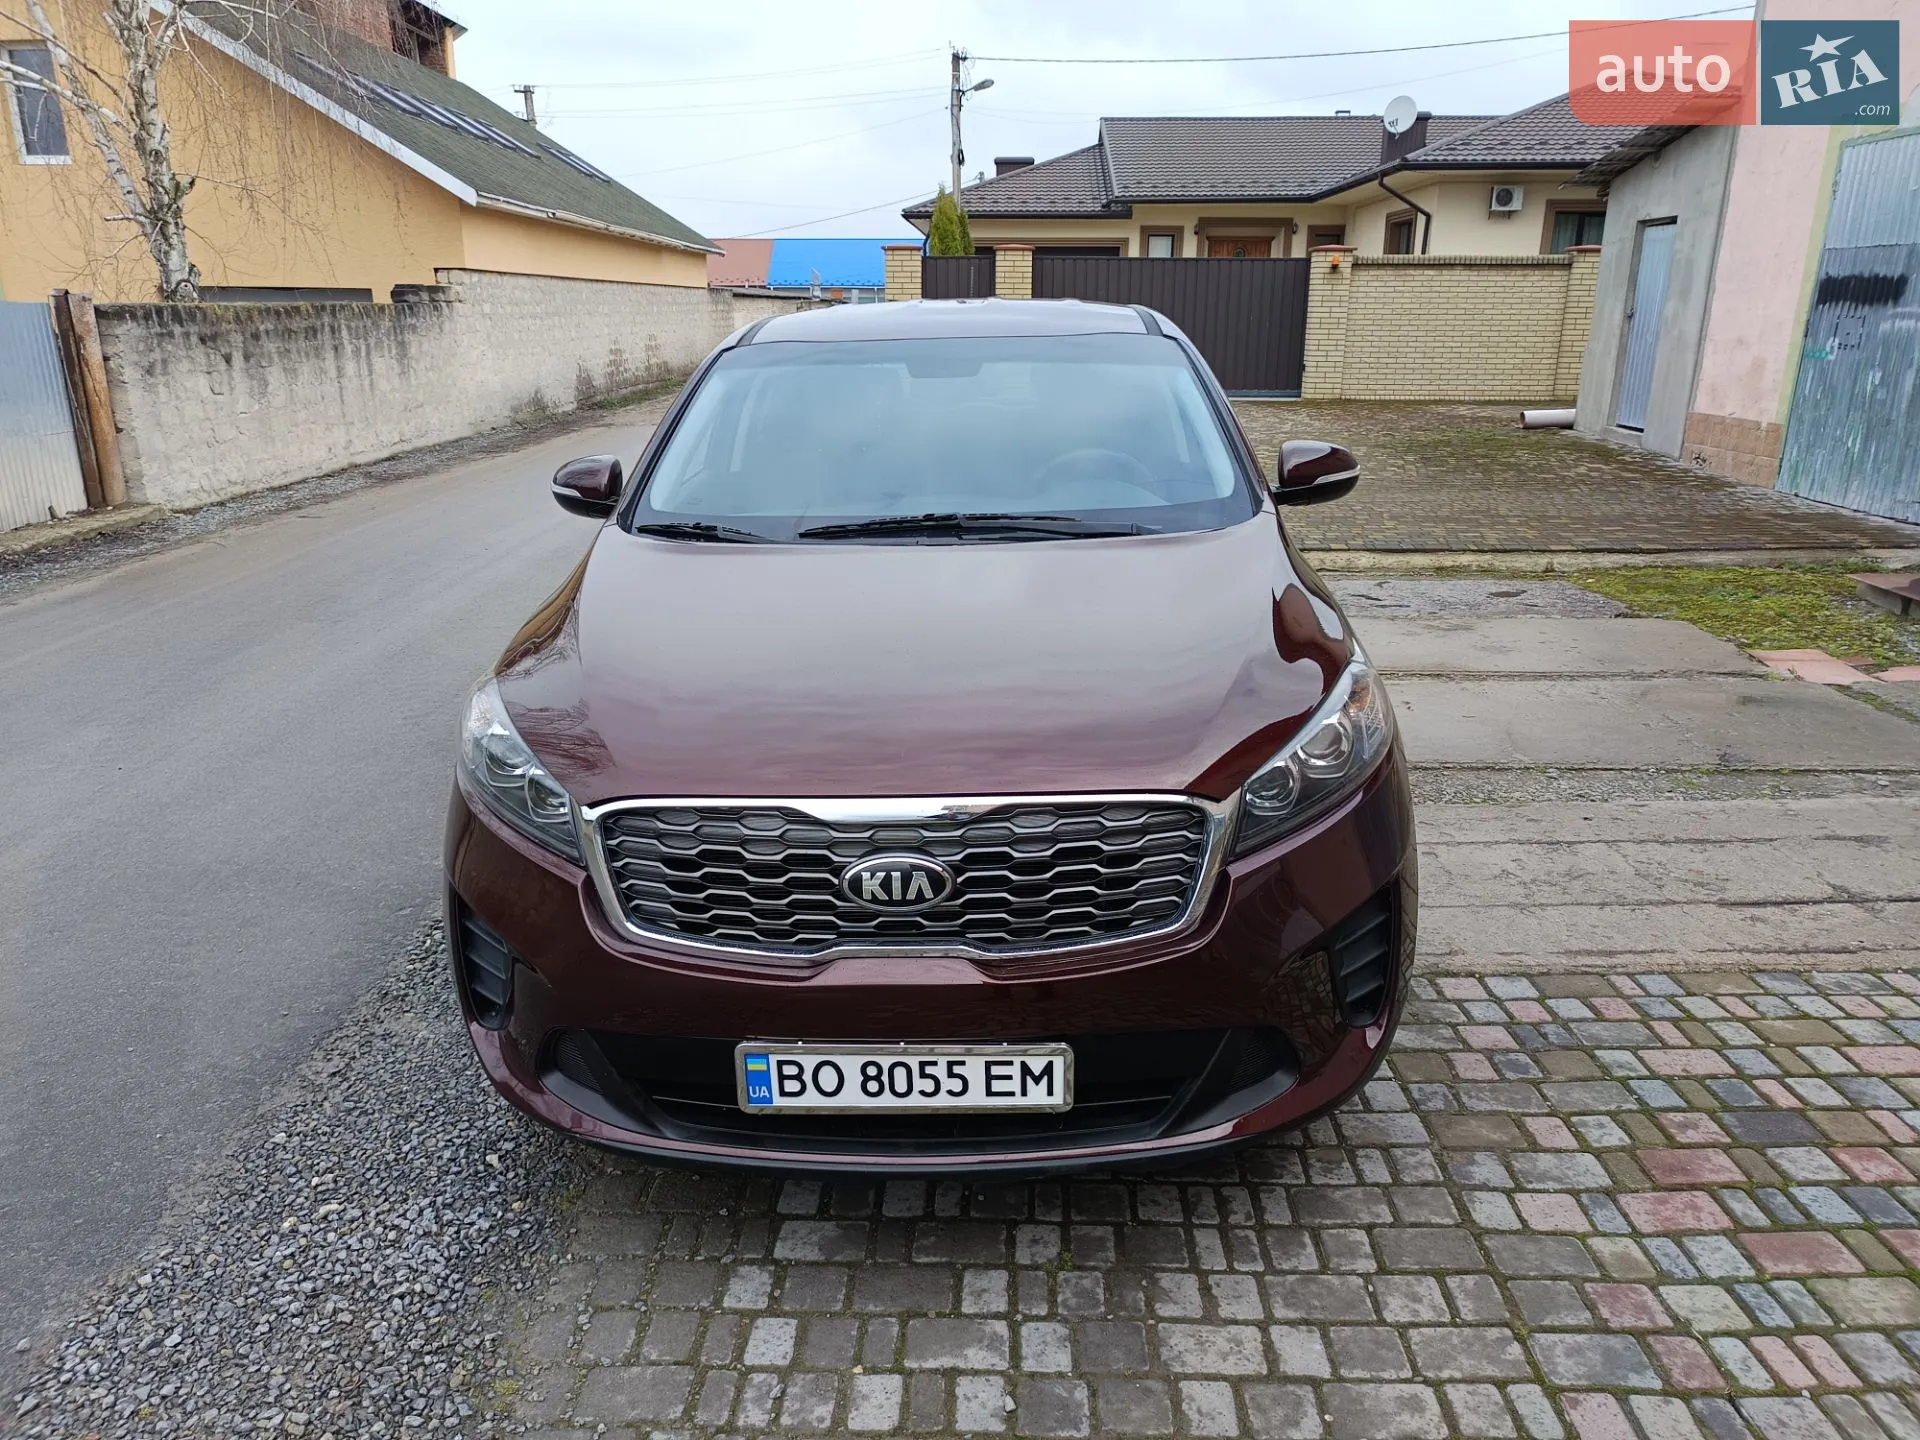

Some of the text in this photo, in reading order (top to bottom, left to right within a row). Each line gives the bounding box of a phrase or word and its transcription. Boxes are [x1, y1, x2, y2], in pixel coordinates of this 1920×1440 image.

[861, 871, 934, 900] KIA
[749, 1086, 770, 1098] UA
[776, 1060, 1054, 1098] BO 8055 EM
